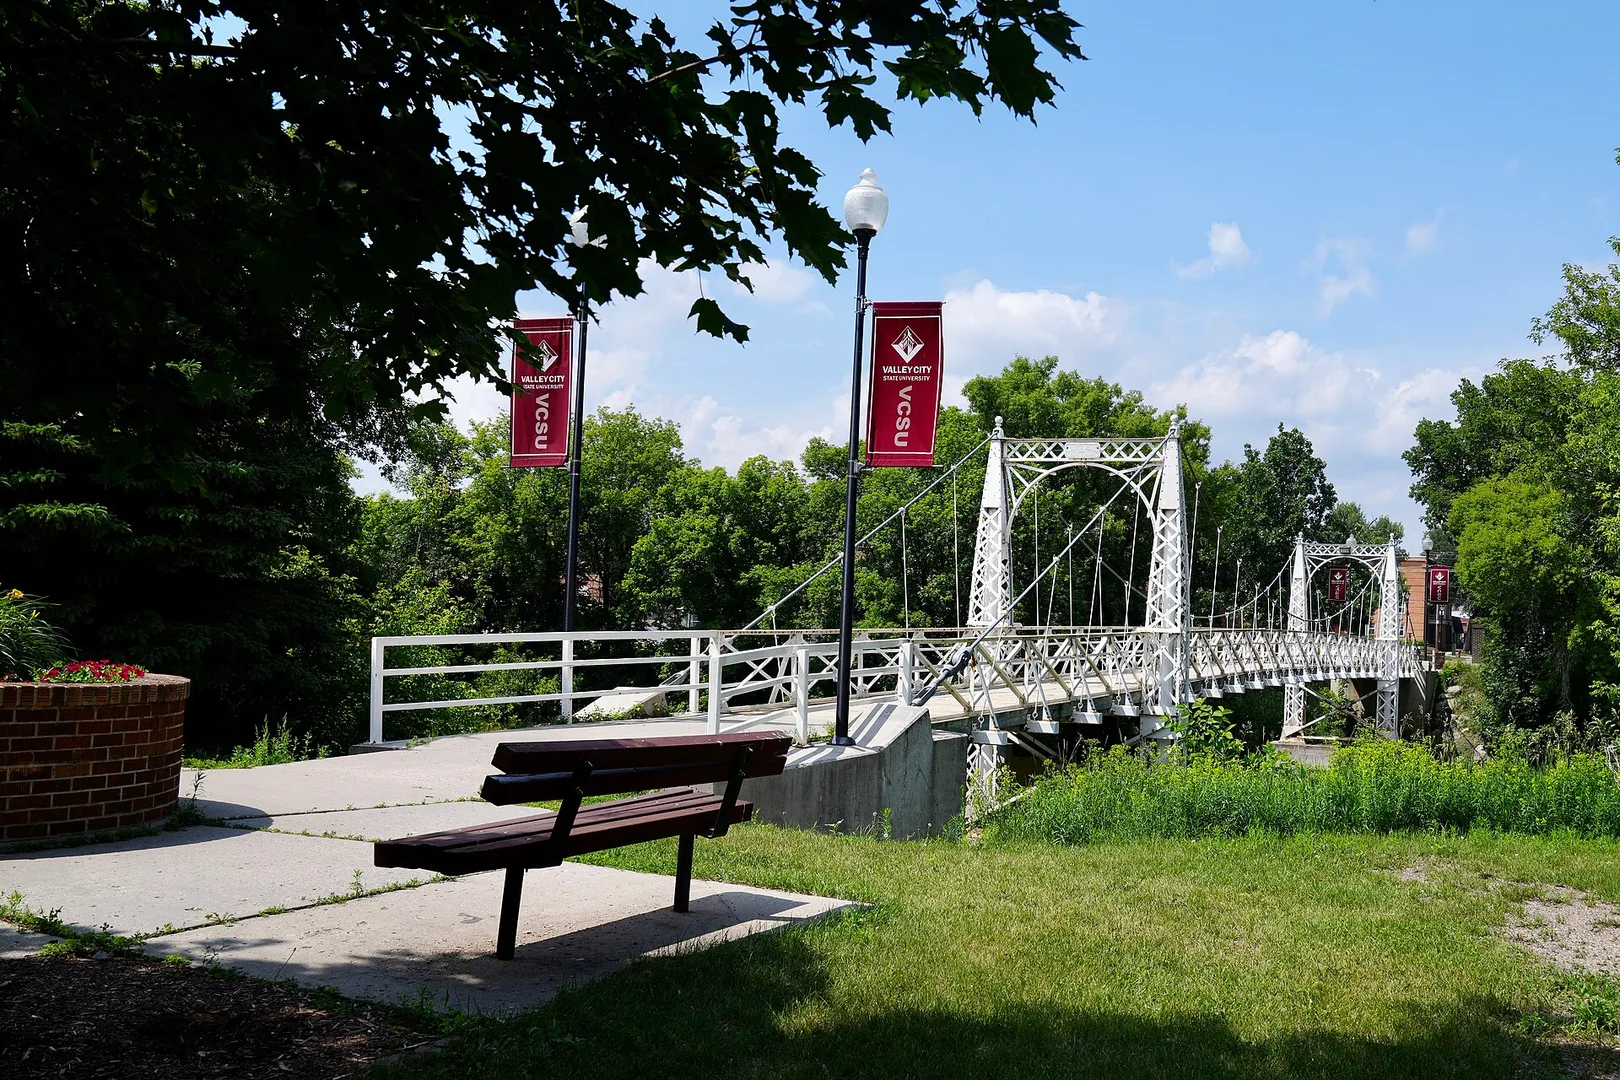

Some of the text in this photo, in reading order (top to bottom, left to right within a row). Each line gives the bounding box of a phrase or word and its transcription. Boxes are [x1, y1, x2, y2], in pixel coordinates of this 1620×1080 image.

[521, 375, 565, 383] VALLEY CITY
[882, 365, 932, 374] VALLEY CITY
[534, 393, 550, 450] VCSU
[894, 385, 913, 447] VCSU
